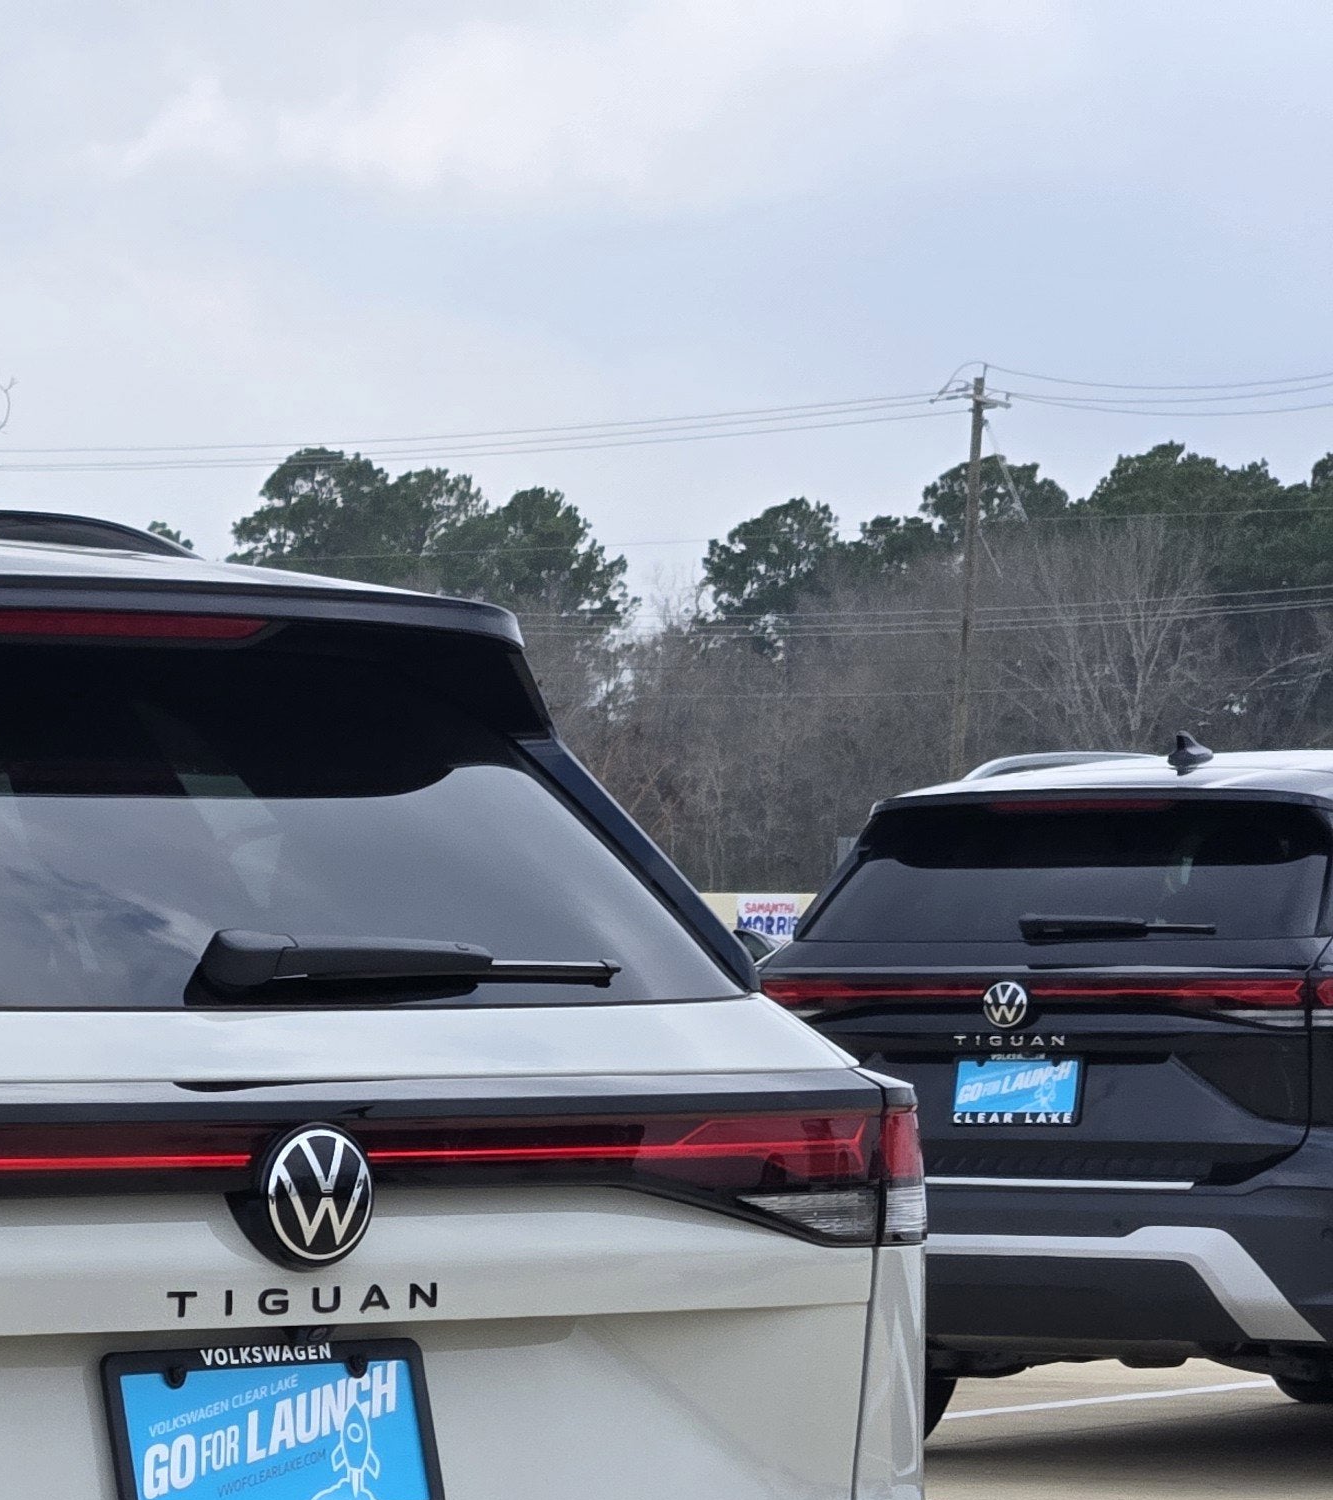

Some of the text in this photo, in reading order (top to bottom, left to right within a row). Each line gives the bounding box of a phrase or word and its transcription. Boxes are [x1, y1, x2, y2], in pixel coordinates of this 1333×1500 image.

[953, 1035, 1066, 1046] TIGUAN
[1000, 1060, 1074, 1094] LAUNCH
[953, 1112, 1072, 1124] CLEAR LAKE
[166, 1282, 438, 1318] TIGUAN
[200, 1342, 332, 1367] VOLKSWAGEN
[148, 1373, 300, 1437] VOLKSWAGEN CLEAR LAKE
[143, 1360, 397, 1499] GO FOR LAUNCH
